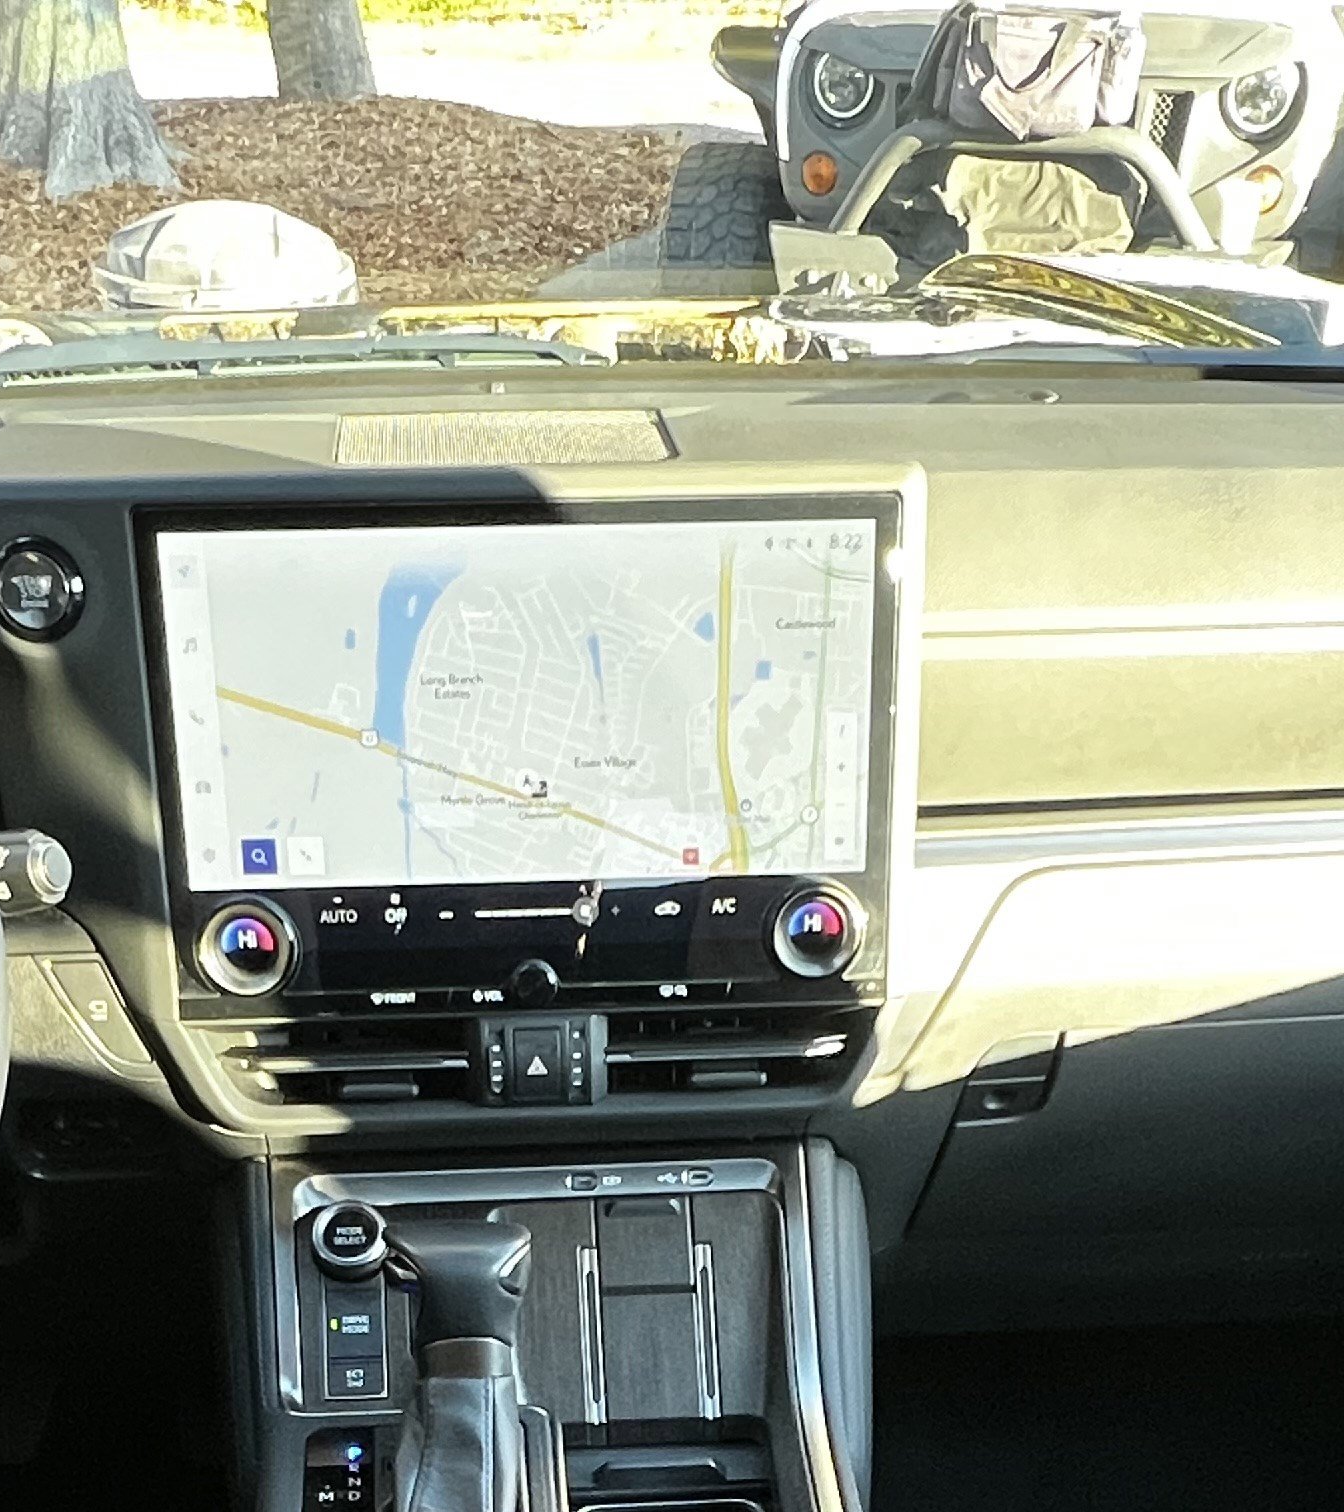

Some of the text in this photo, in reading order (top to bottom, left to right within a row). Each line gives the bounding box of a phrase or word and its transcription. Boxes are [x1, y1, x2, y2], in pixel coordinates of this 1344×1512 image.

[711, 897, 738, 914] A/C
[320, 909, 358, 924] AUTO
[348, 1477, 361, 1487] N
[318, 1490, 335, 1502] M
[348, 1490, 361, 1502] D
